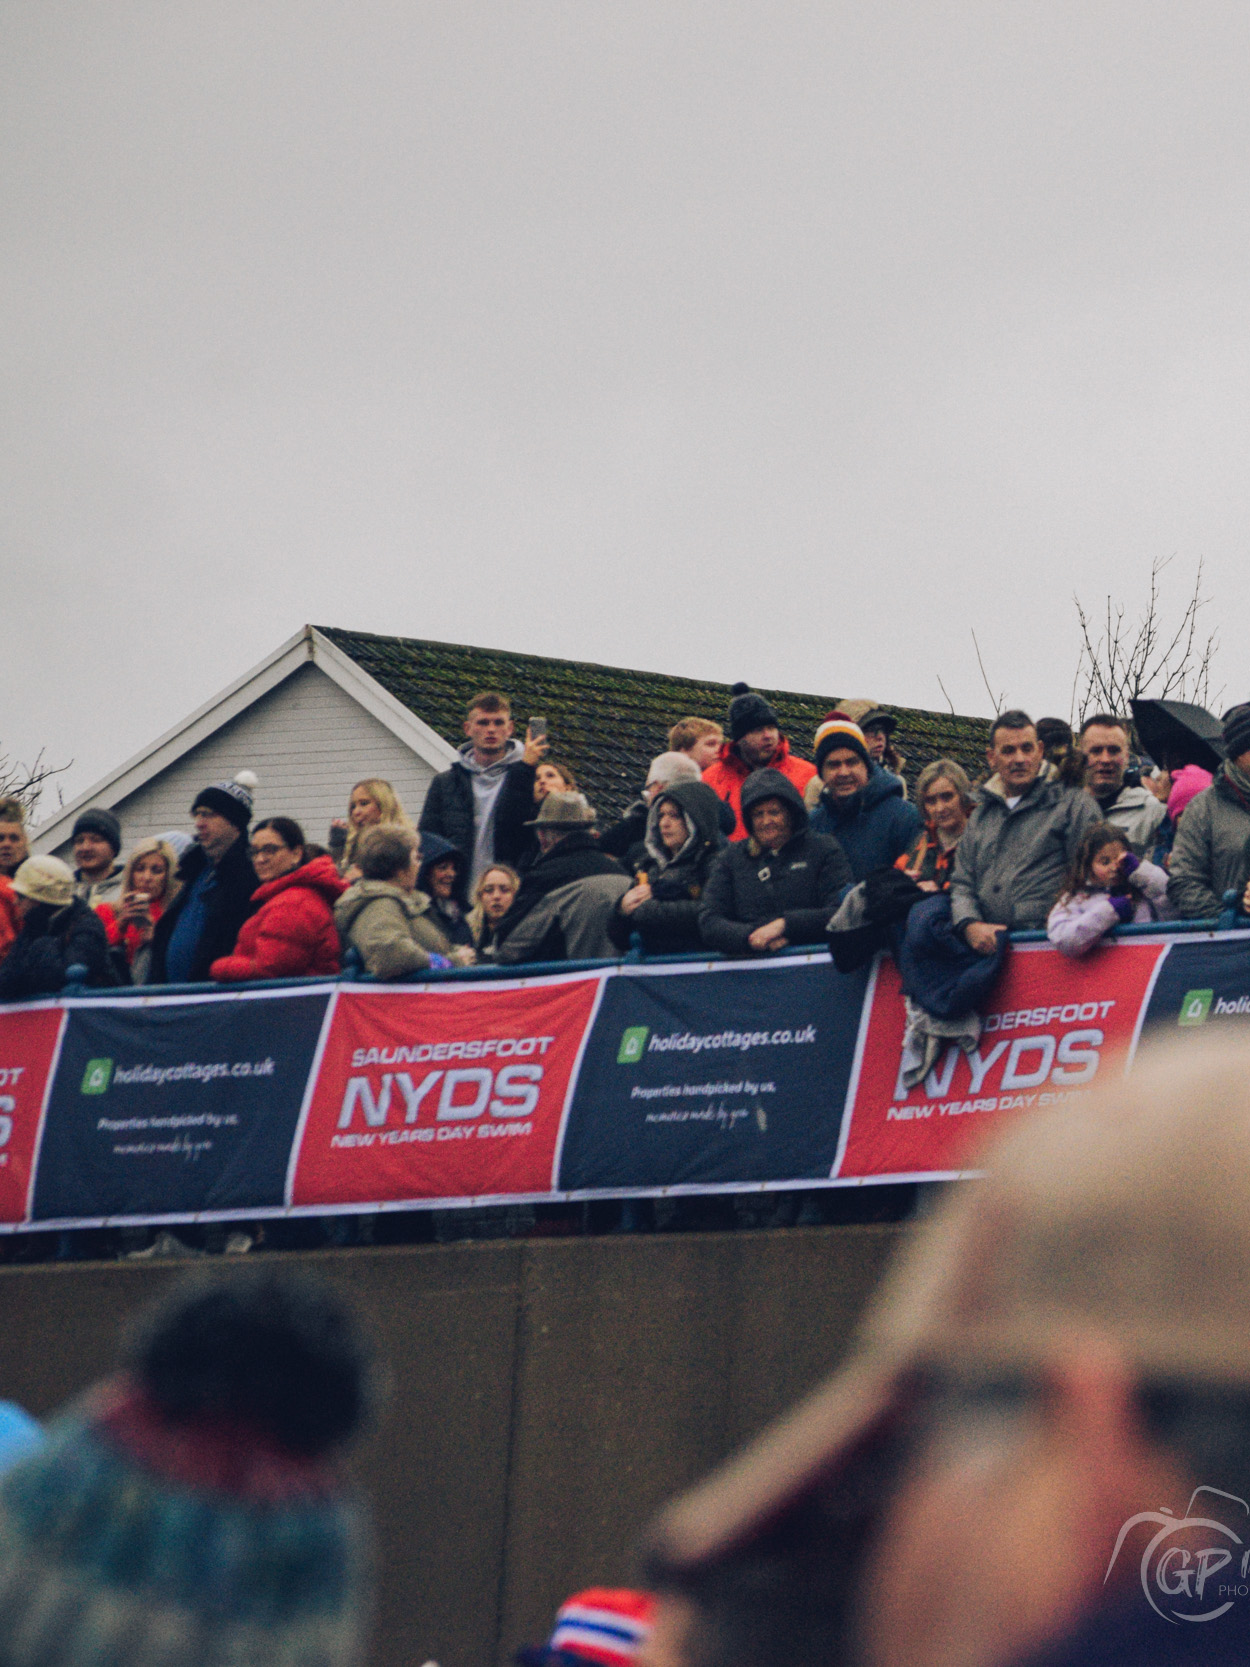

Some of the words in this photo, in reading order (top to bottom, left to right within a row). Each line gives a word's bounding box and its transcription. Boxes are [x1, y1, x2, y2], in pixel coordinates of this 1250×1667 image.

[983, 1000, 1115, 1032] DERSFOOT
[351, 1036, 555, 1067] SAUNDERSFOOT
[647, 1024, 817, 1054] holidaycottages.co.uk
[893, 1028, 1104, 1101] NYDS
[337, 1064, 544, 1129] NYDS
[886, 1106, 935, 1121] NEW
[938, 1097, 998, 1116] YEARS
[1000, 1094, 1037, 1110] DAY
[330, 1133, 376, 1148] NEW
[379, 1127, 434, 1144] YEARS
[436, 1125, 476, 1140] DAY
[476, 1121, 532, 1138] SWIM
